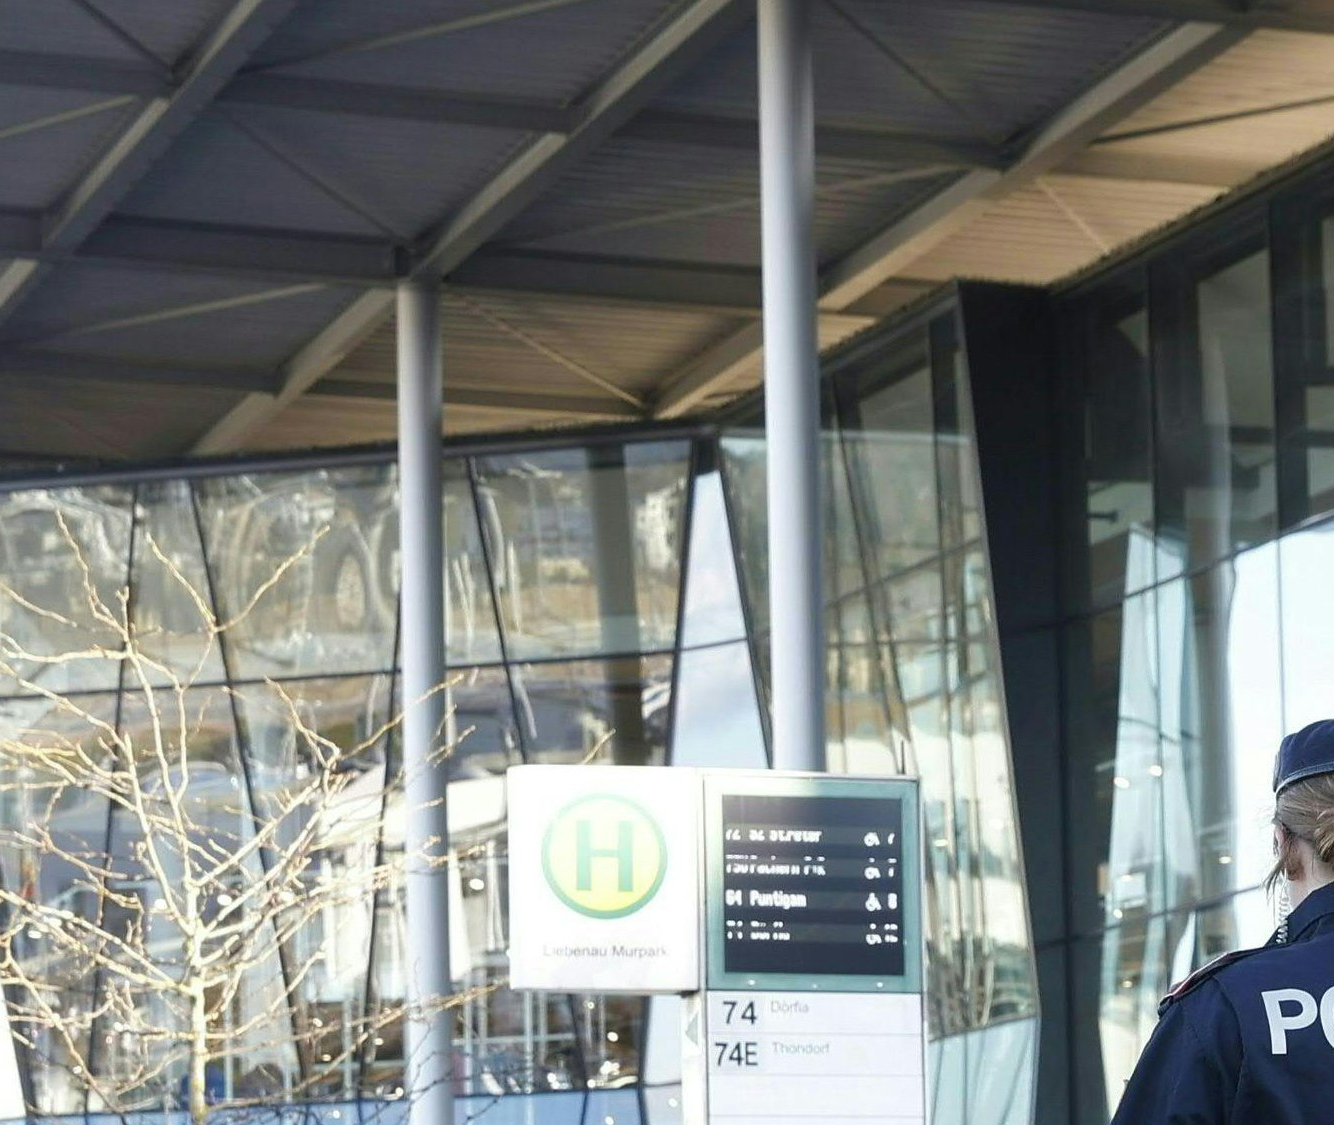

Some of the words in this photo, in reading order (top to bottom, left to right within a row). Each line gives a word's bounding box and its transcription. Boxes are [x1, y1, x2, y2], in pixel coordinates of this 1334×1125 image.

[576, 820, 633, 892] H
[723, 1001, 758, 1025] 74
[715, 1042, 758, 1066] 74E
